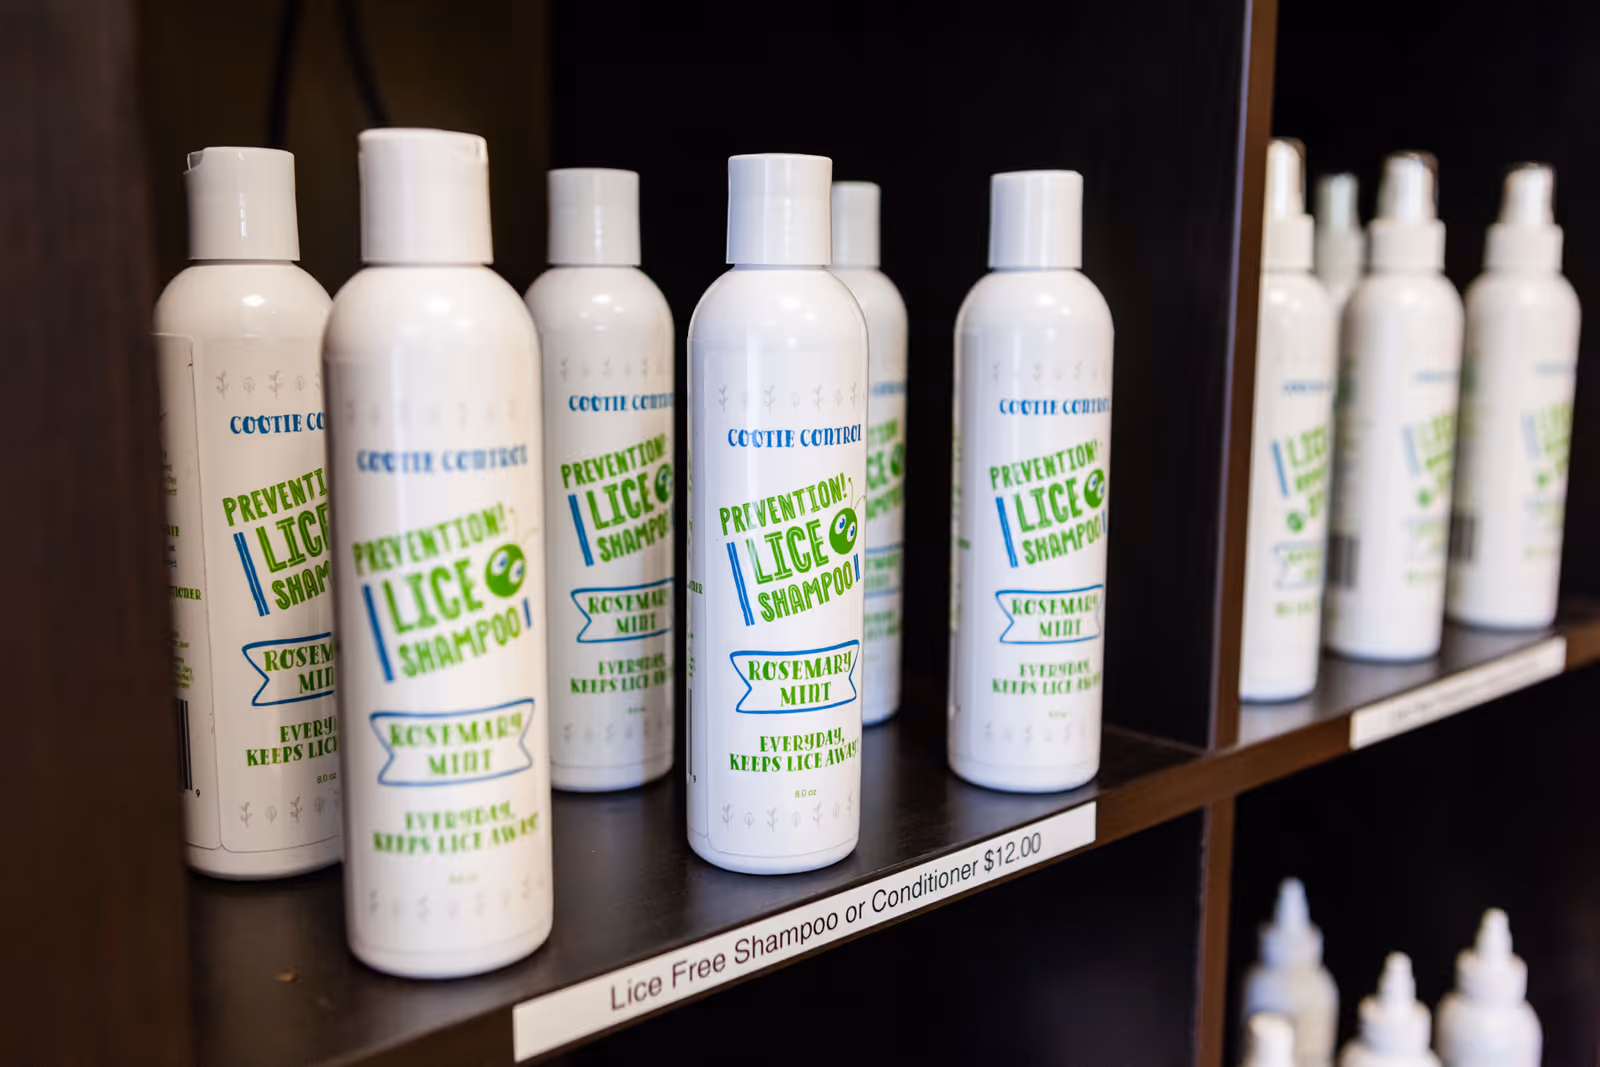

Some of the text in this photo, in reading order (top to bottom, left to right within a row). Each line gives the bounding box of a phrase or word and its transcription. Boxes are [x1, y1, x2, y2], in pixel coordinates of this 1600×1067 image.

[569, 394, 628, 413] COOTIE
[1000, 398, 1057, 416] COOTIE
[230, 413, 303, 434] COOTIE
[727, 428, 795, 448] COOTIE
[799, 423, 862, 447] CONTROL
[561, 432, 669, 489] PREVENTION
[222, 467, 327, 527] PREVENTI
[585, 471, 655, 531] LICE
[719, 472, 848, 536] PREVENTION!
[1014, 476, 1083, 533] LICE
[352, 502, 508, 577] PREVENTION!
[746, 518, 830, 585] LICE
[1022, 514, 1101, 565] SHAMPOO
[272, 560, 331, 610] SHAM
[382, 557, 484, 634] LICE
[757, 560, 853, 623] SHAMPOO
[263, 641, 335, 672] ROSEM
[397, 606, 522, 678] SHAMPOO
[298, 665, 335, 694] MIN
[748, 650, 852, 681] ROSEMARY
[780, 681, 832, 707] MINT
[280, 715, 337, 743] EVERY
[760, 727, 845, 752] EVERYDAY,
[246, 743, 303, 767] KEEPS
[428, 749, 492, 775] MINT
[729, 753, 781, 773] KEEPS
[786, 752, 823, 772] LICE
[195, 788, 201, 798] 9
[610, 831, 1042, 1011] Lice Free Shampoo or Conditioner $12.00
